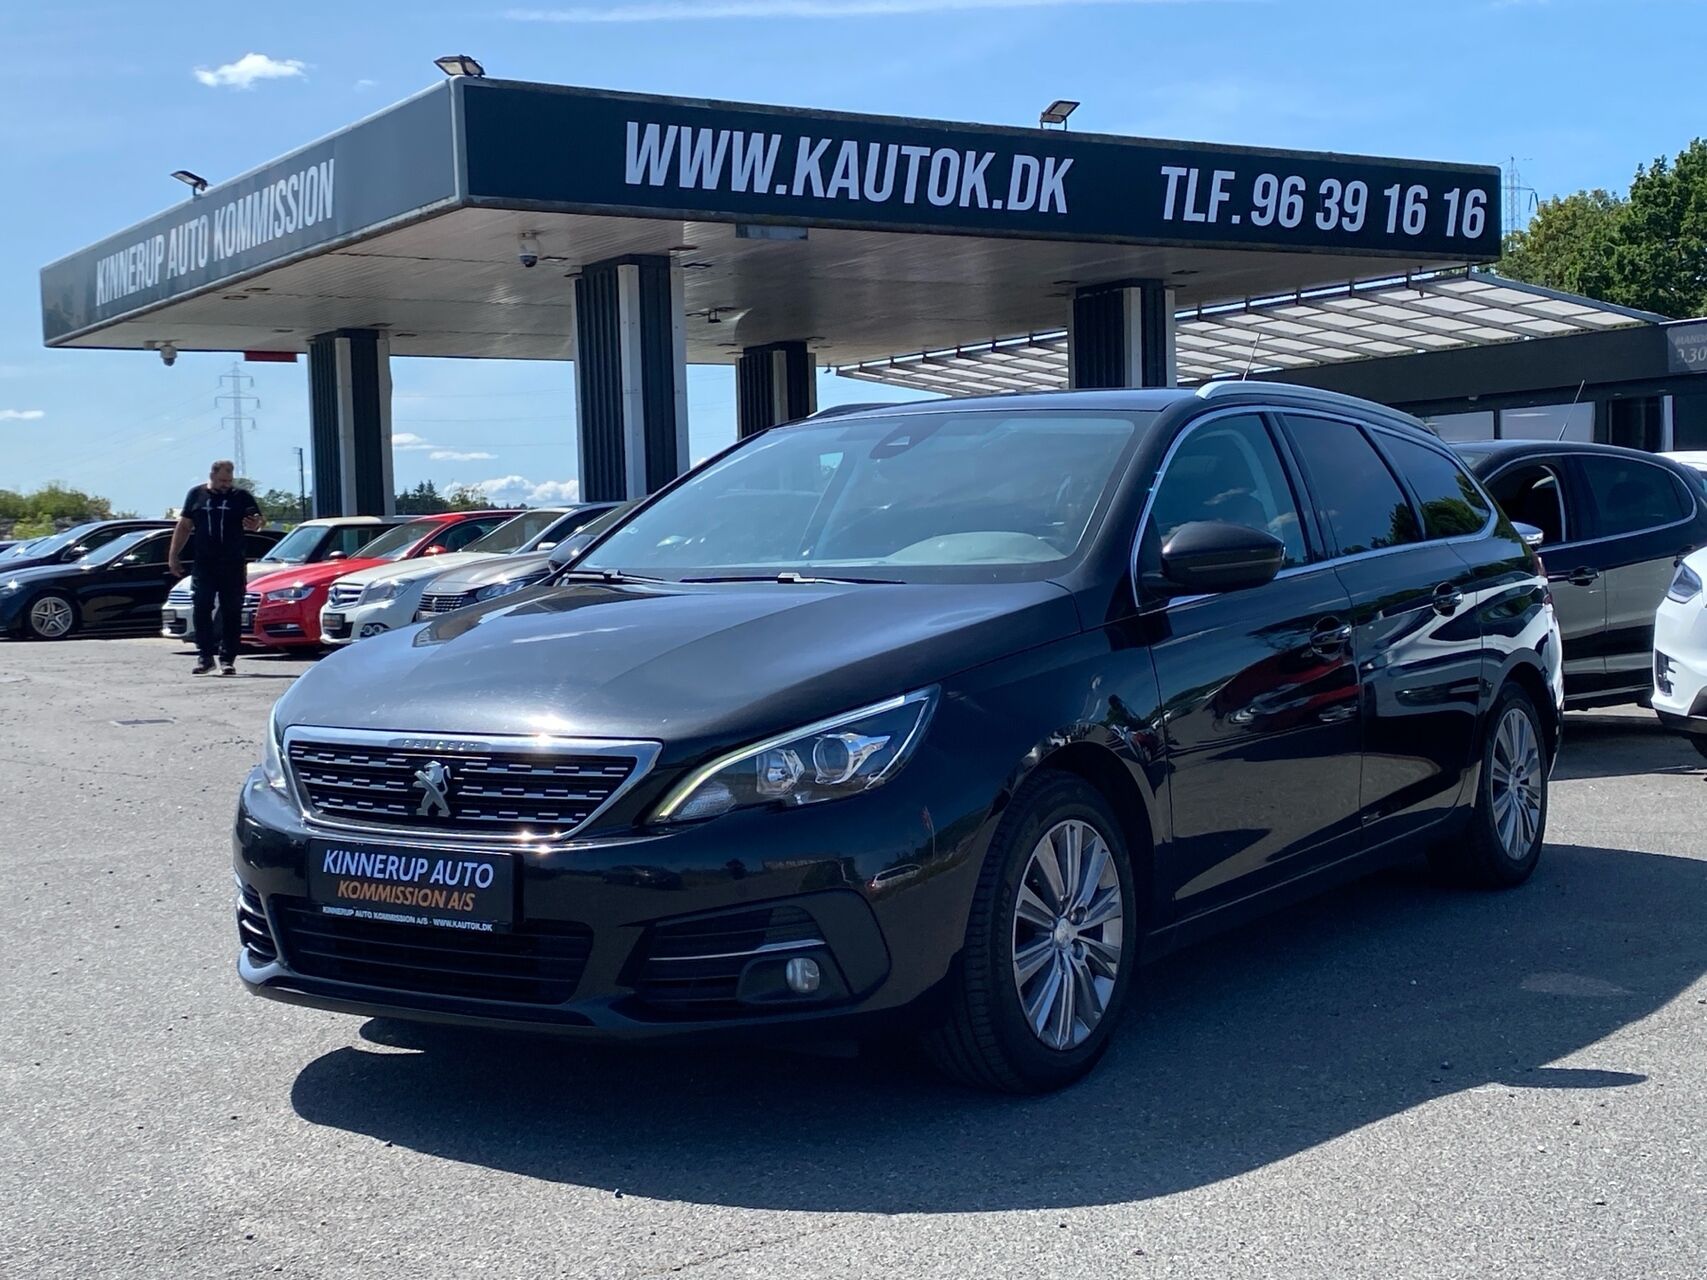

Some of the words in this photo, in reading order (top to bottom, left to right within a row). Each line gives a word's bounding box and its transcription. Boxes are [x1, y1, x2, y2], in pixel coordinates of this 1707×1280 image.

[625, 121, 1074, 214] WWW.KAUTOK.DK
[1161, 166, 1240, 224] TLF.
[1251, 173, 1306, 228] 96
[1316, 178, 1368, 232] 39
[1384, 183, 1429, 235] 16
[1444, 188, 1487, 239] 16
[96, 234, 165, 307] KINNERUP
[167, 214, 209, 279] AUTO
[213, 158, 335, 262] KOMMISSION
[323, 849, 428, 882] KINNERUP
[430, 859, 494, 888] AUTO
[337, 880, 446, 908] KOMMISSION
[447, 891, 476, 911] A/S
[355, 909, 373, 919] AUTO
[373, 911, 416, 924] KOMMISSION
[433, 918, 493, 932] WWW.KAUTOK.DK
